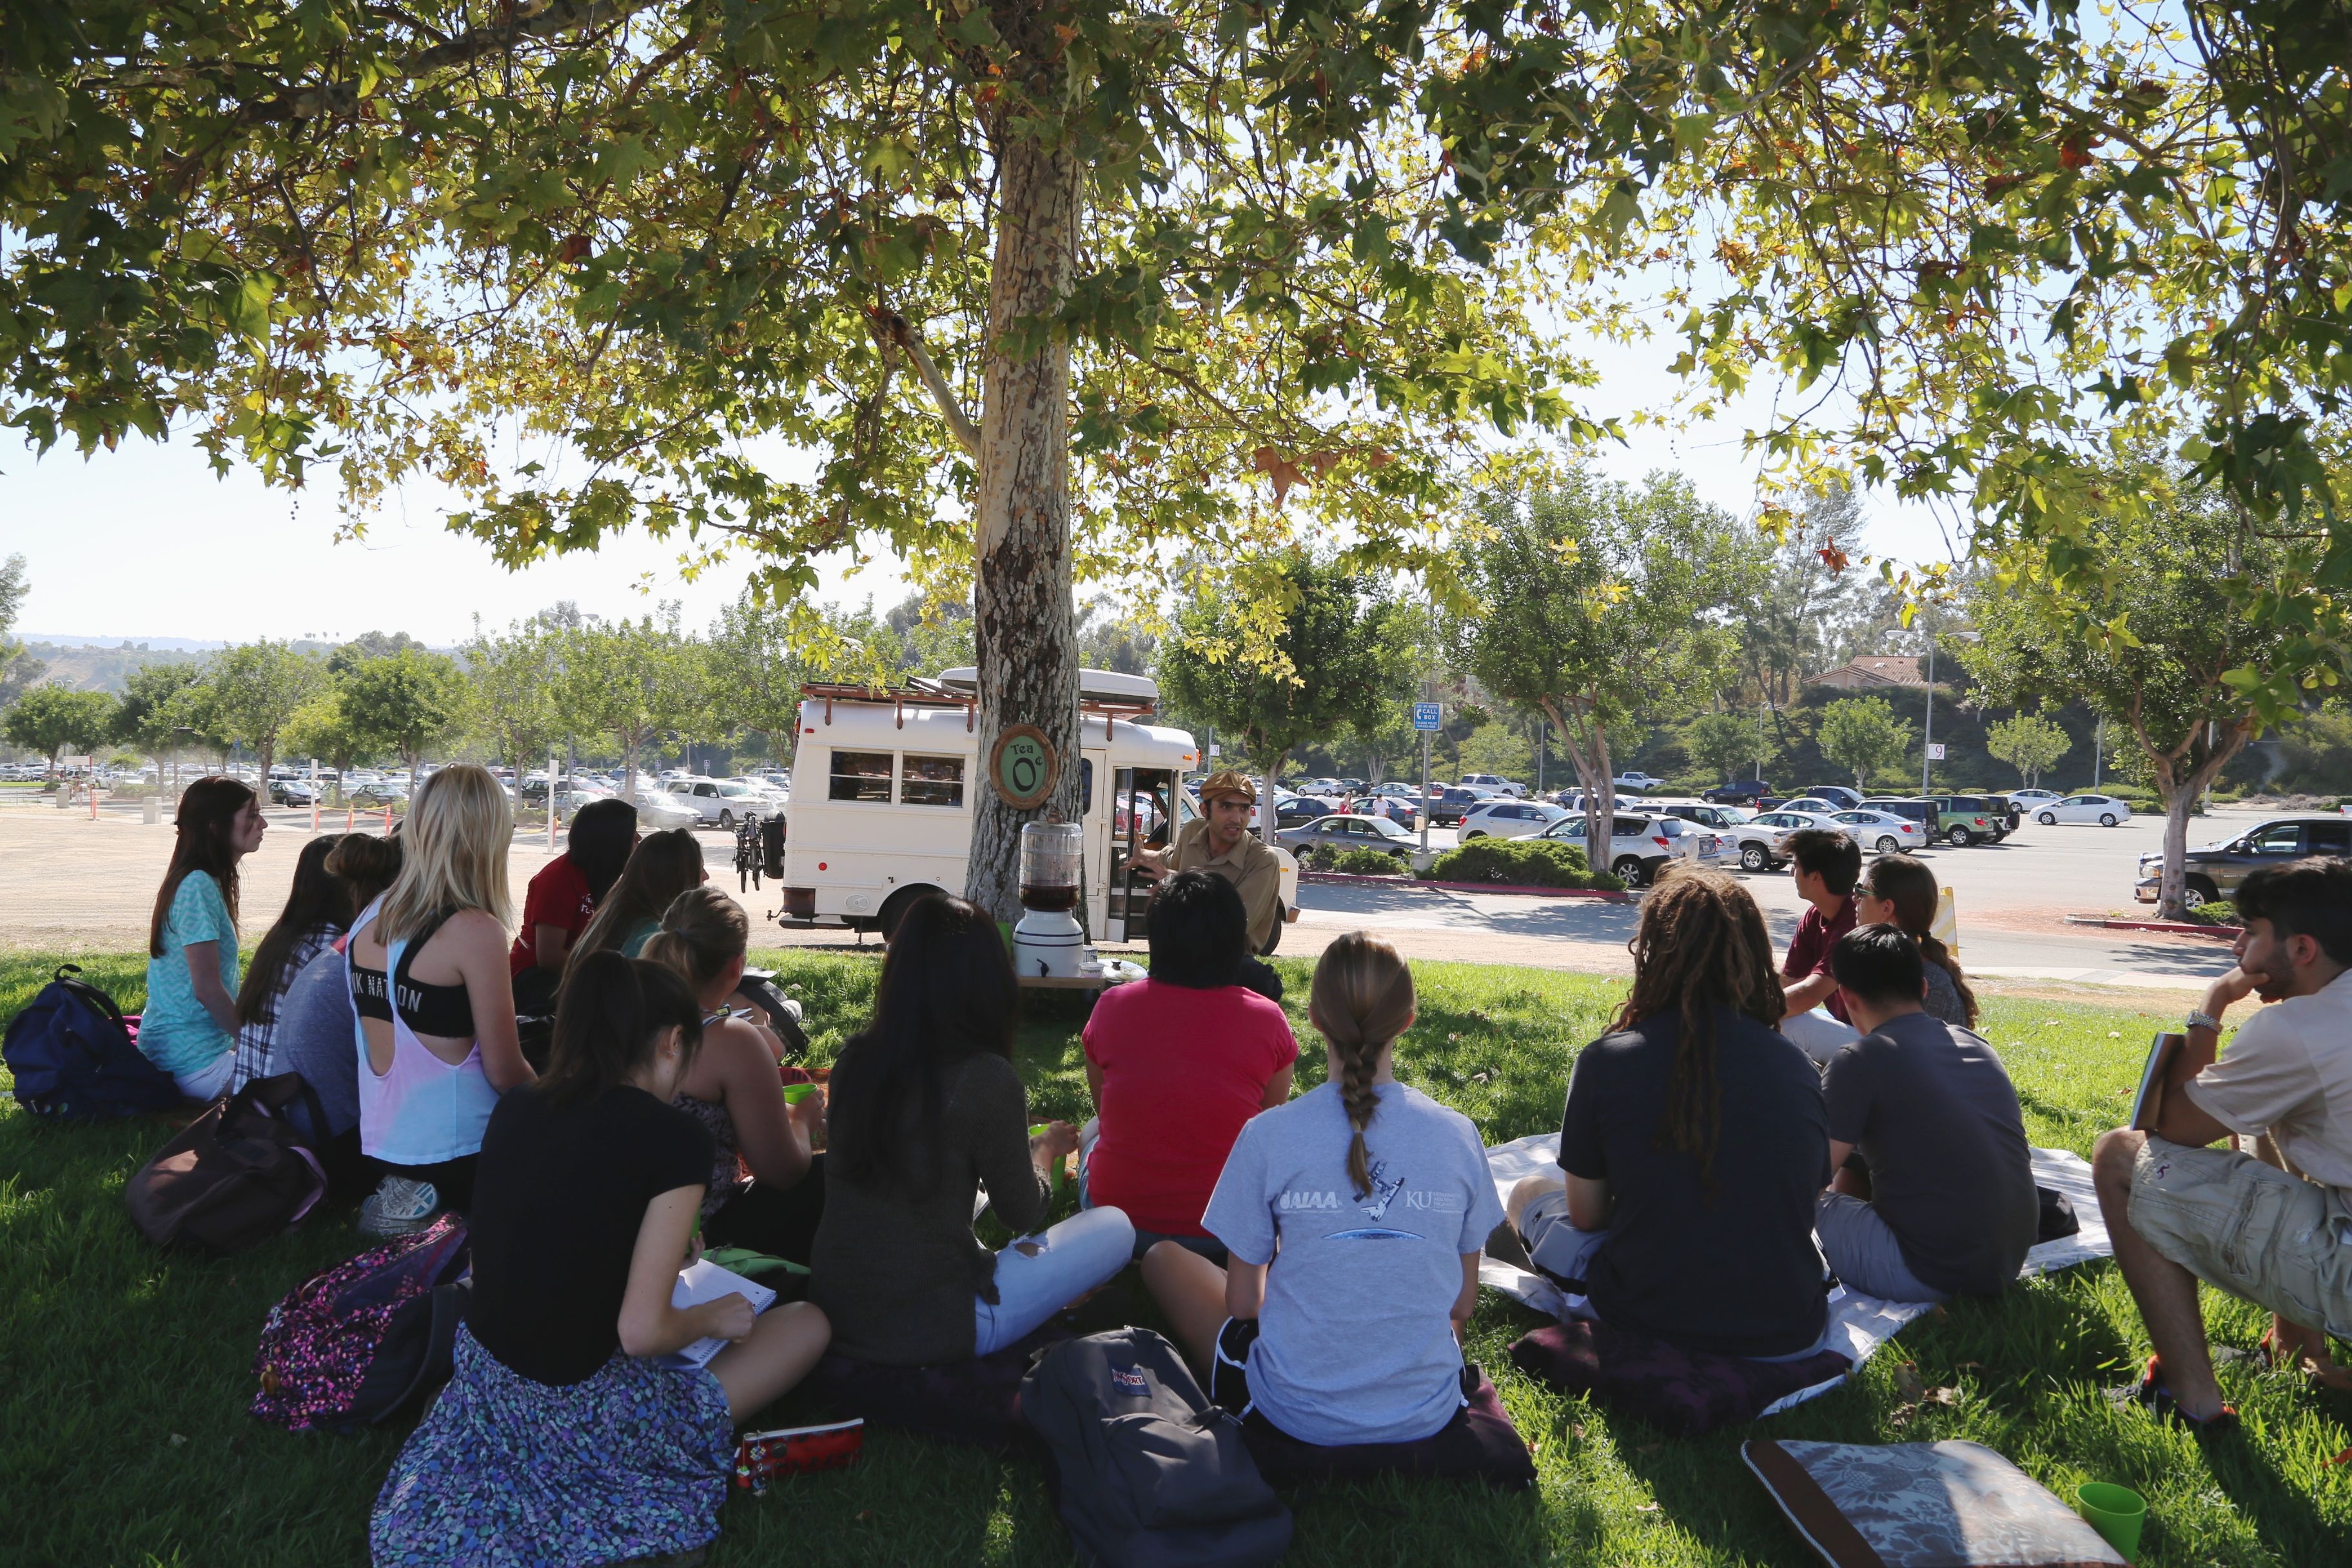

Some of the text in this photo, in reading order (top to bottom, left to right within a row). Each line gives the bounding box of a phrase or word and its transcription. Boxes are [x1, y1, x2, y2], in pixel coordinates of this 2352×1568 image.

[1010, 743, 1034, 755] Tea
[1215, 745, 1219, 754] 9
[1936, 745, 1942, 758] 9
[351, 972, 422, 1012] NK NATON
[1406, 1191, 1432, 1210] KU
